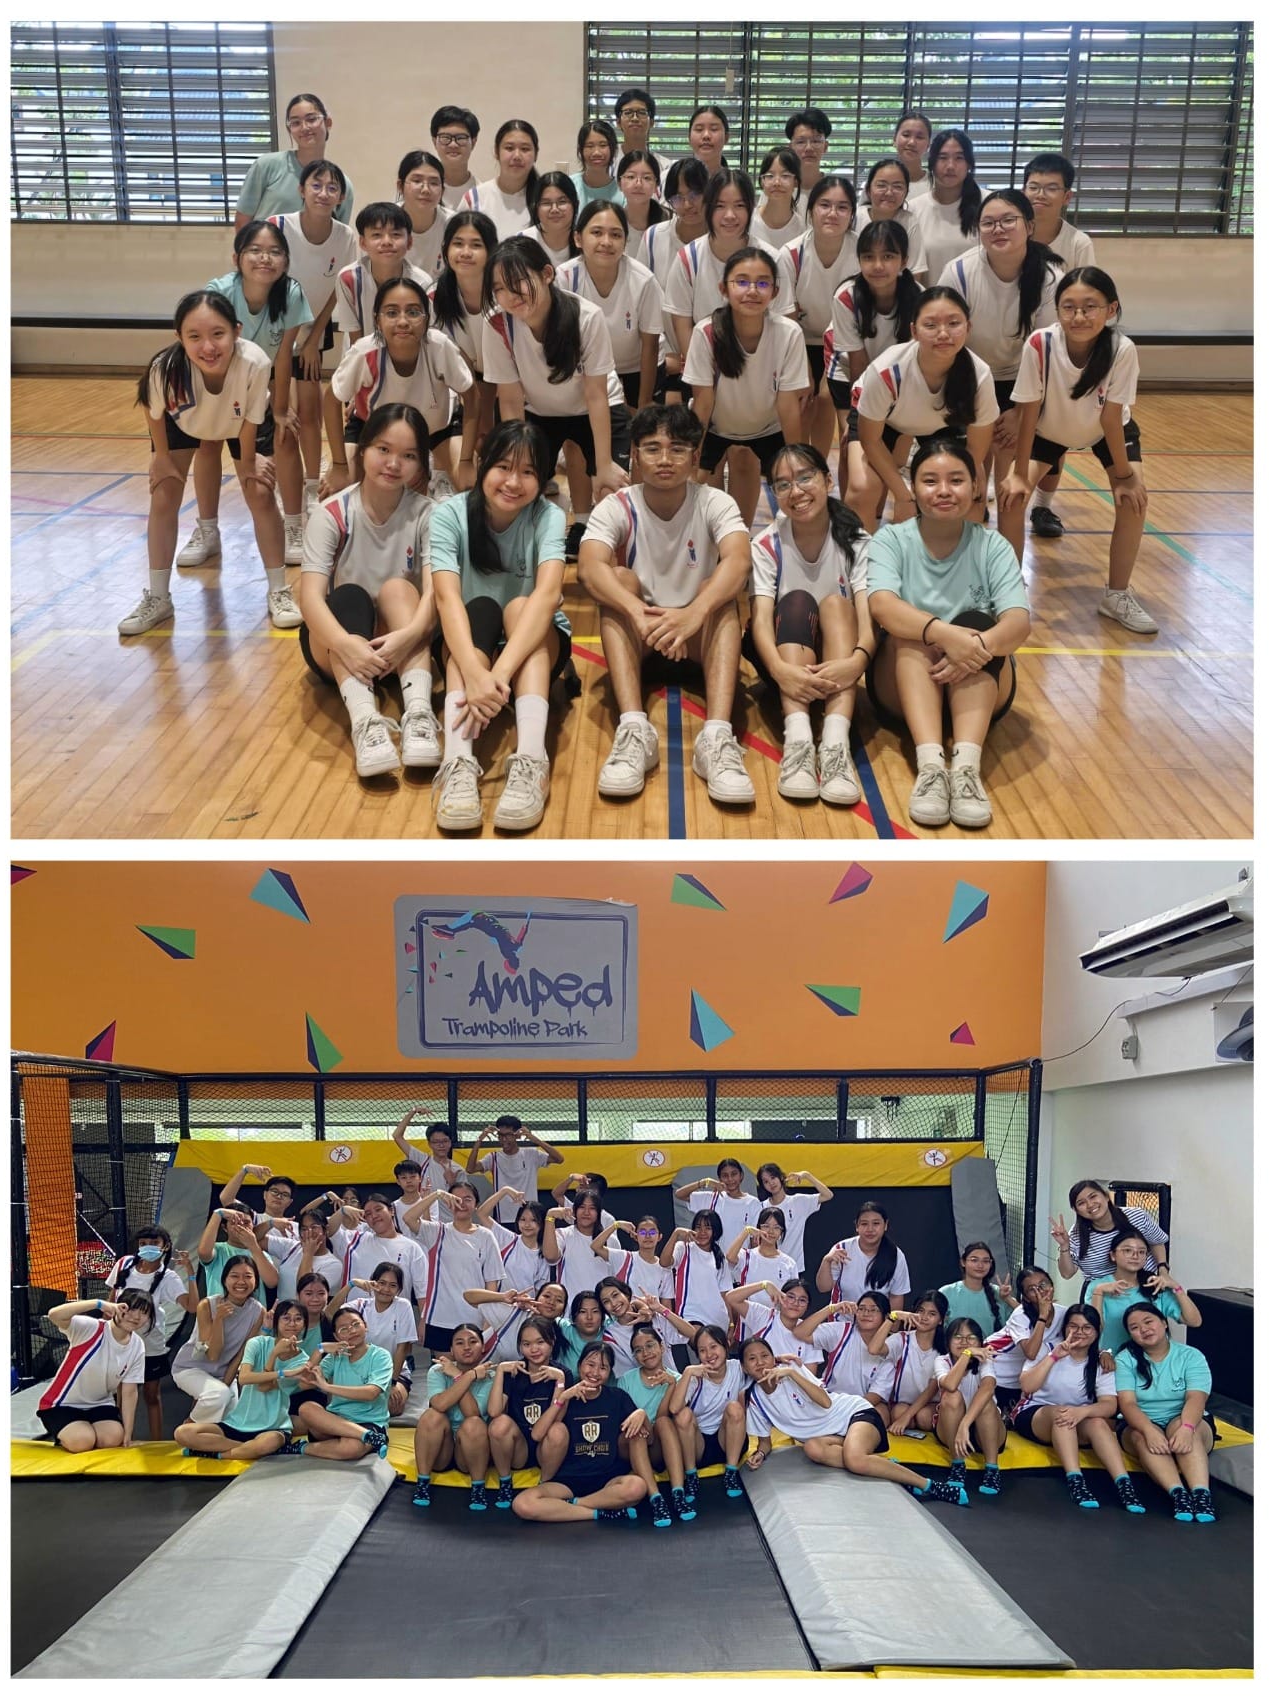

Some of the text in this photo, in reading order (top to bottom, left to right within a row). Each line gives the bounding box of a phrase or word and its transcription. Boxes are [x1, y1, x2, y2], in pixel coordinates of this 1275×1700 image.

[468, 960, 613, 1018] Amped
[442, 1018, 588, 1040] Trampoline Park
[585, 1423, 598, 1437] RR
